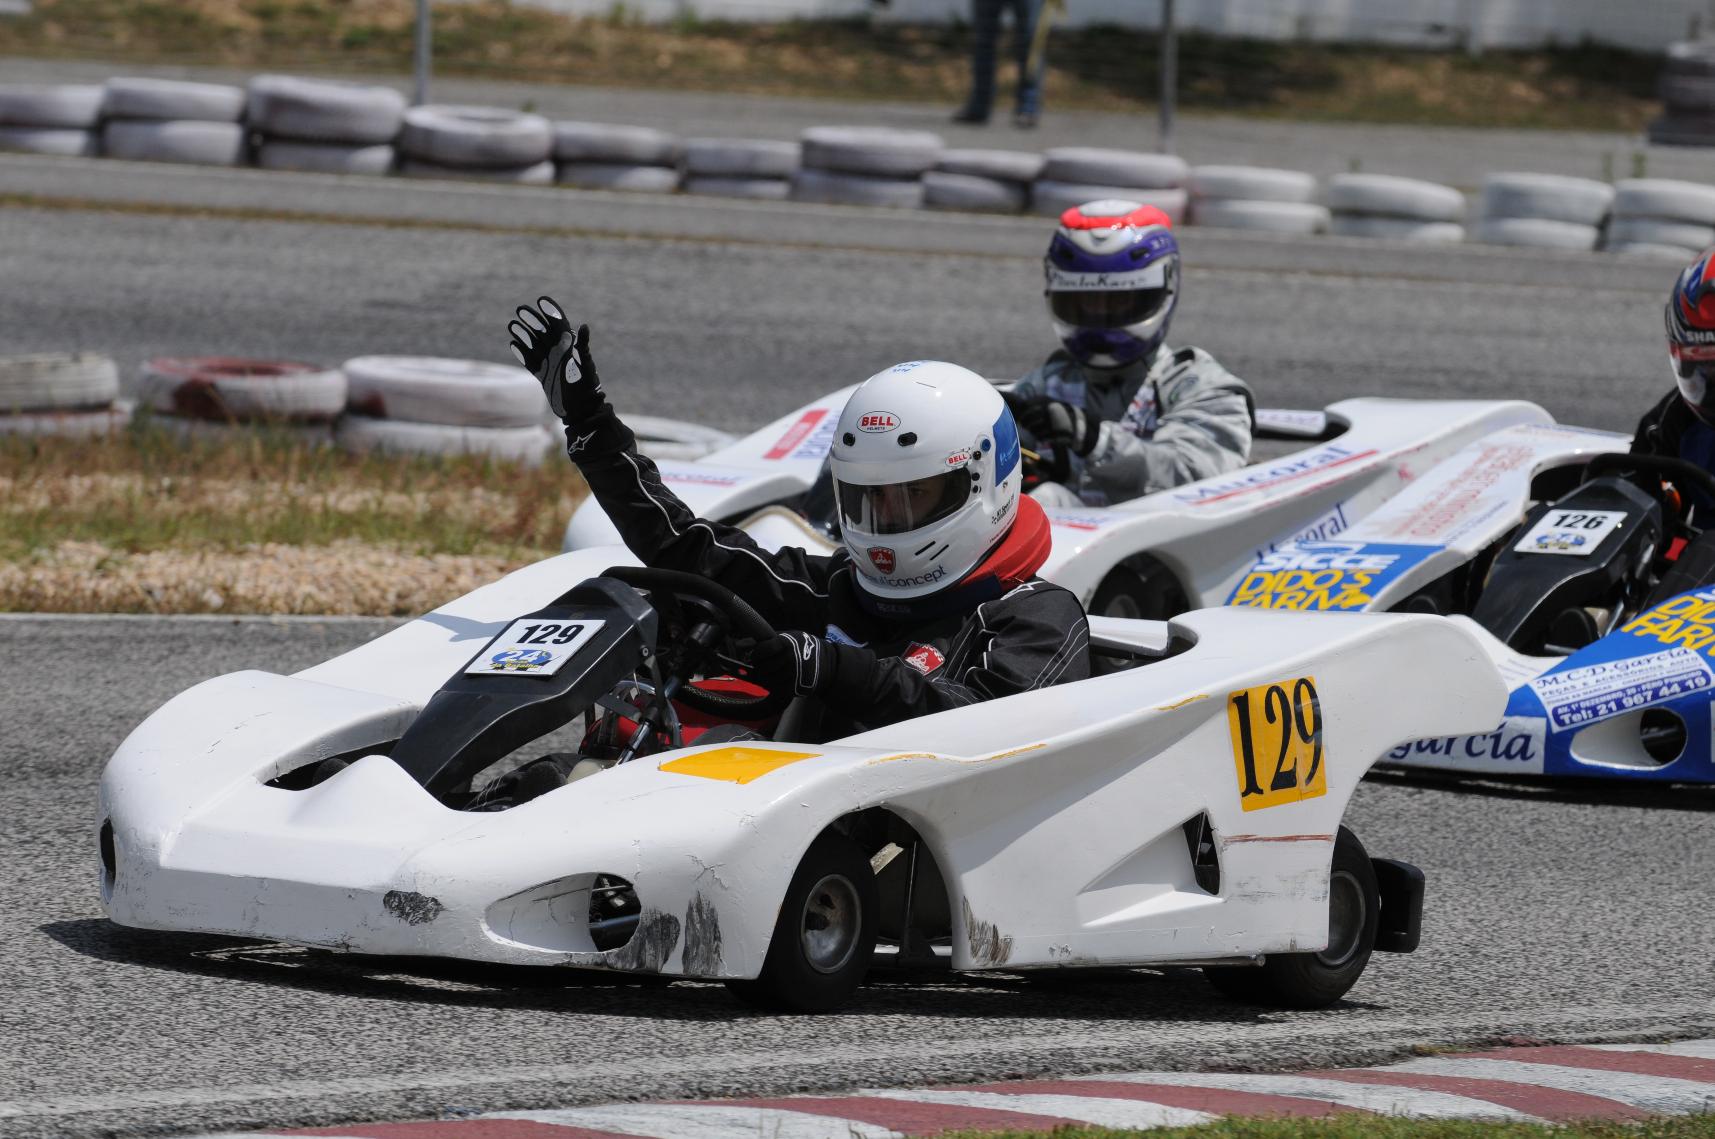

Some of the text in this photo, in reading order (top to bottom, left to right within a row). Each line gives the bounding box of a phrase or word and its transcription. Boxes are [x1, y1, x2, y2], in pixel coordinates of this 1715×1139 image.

[861, 415, 894, 427] BELL
[948, 453, 967, 464] BELL
[1553, 513, 1609, 530] 126
[516, 623, 585, 645] 129
[1620, 611, 1715, 657] FAR
[498, 650, 542, 662] 24
[1560, 675, 1707, 726] Tel: 21 967 44 19
[1231, 677, 1323, 798] 129
